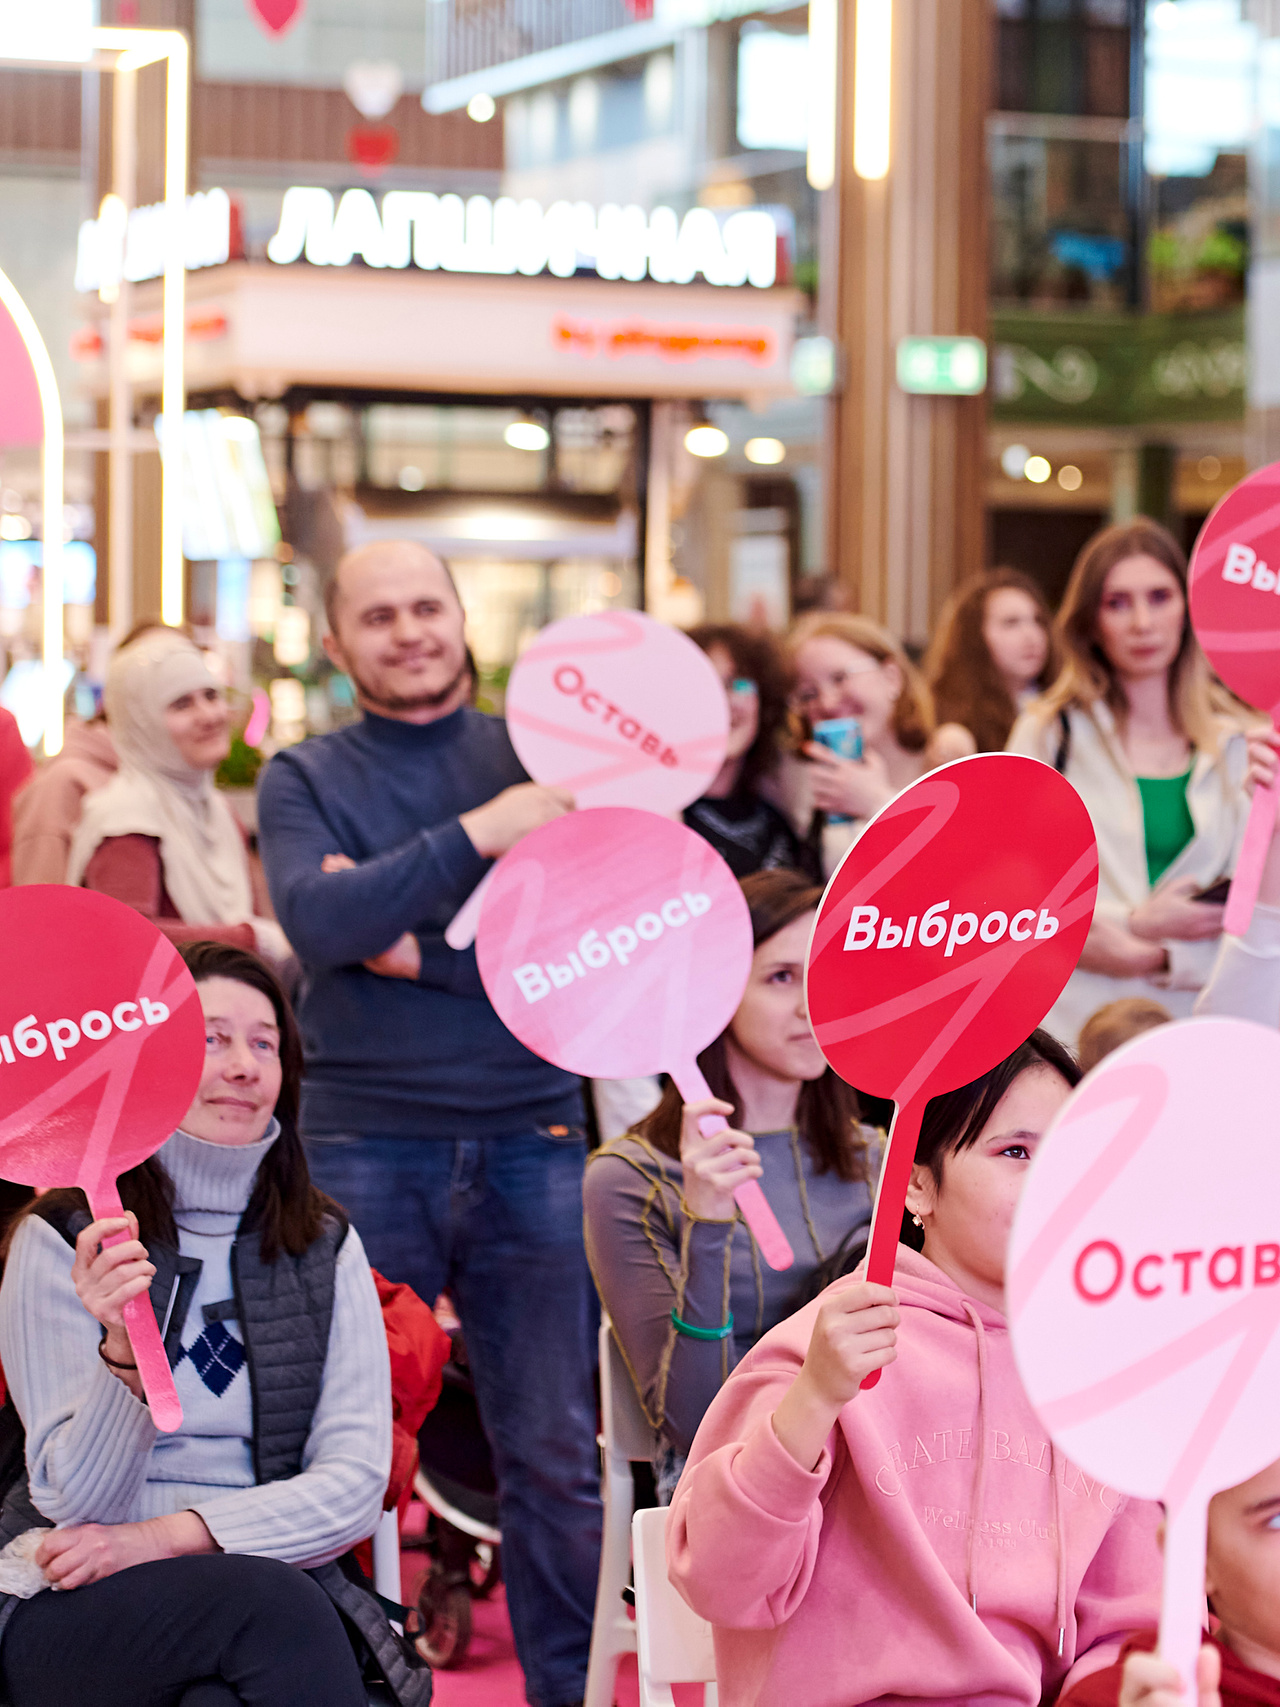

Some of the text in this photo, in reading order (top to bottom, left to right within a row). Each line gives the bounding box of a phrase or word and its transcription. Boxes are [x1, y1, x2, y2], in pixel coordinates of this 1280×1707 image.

[267, 186, 777, 288] ЛАПШИЧНАЯ
[552, 665, 679, 771] Оставь
[512, 887, 712, 1004] Выбрось
[843, 900, 1060, 957] Выбрось
[0, 996, 170, 1064] брось
[923, 1505, 1012, 1535] Welless
